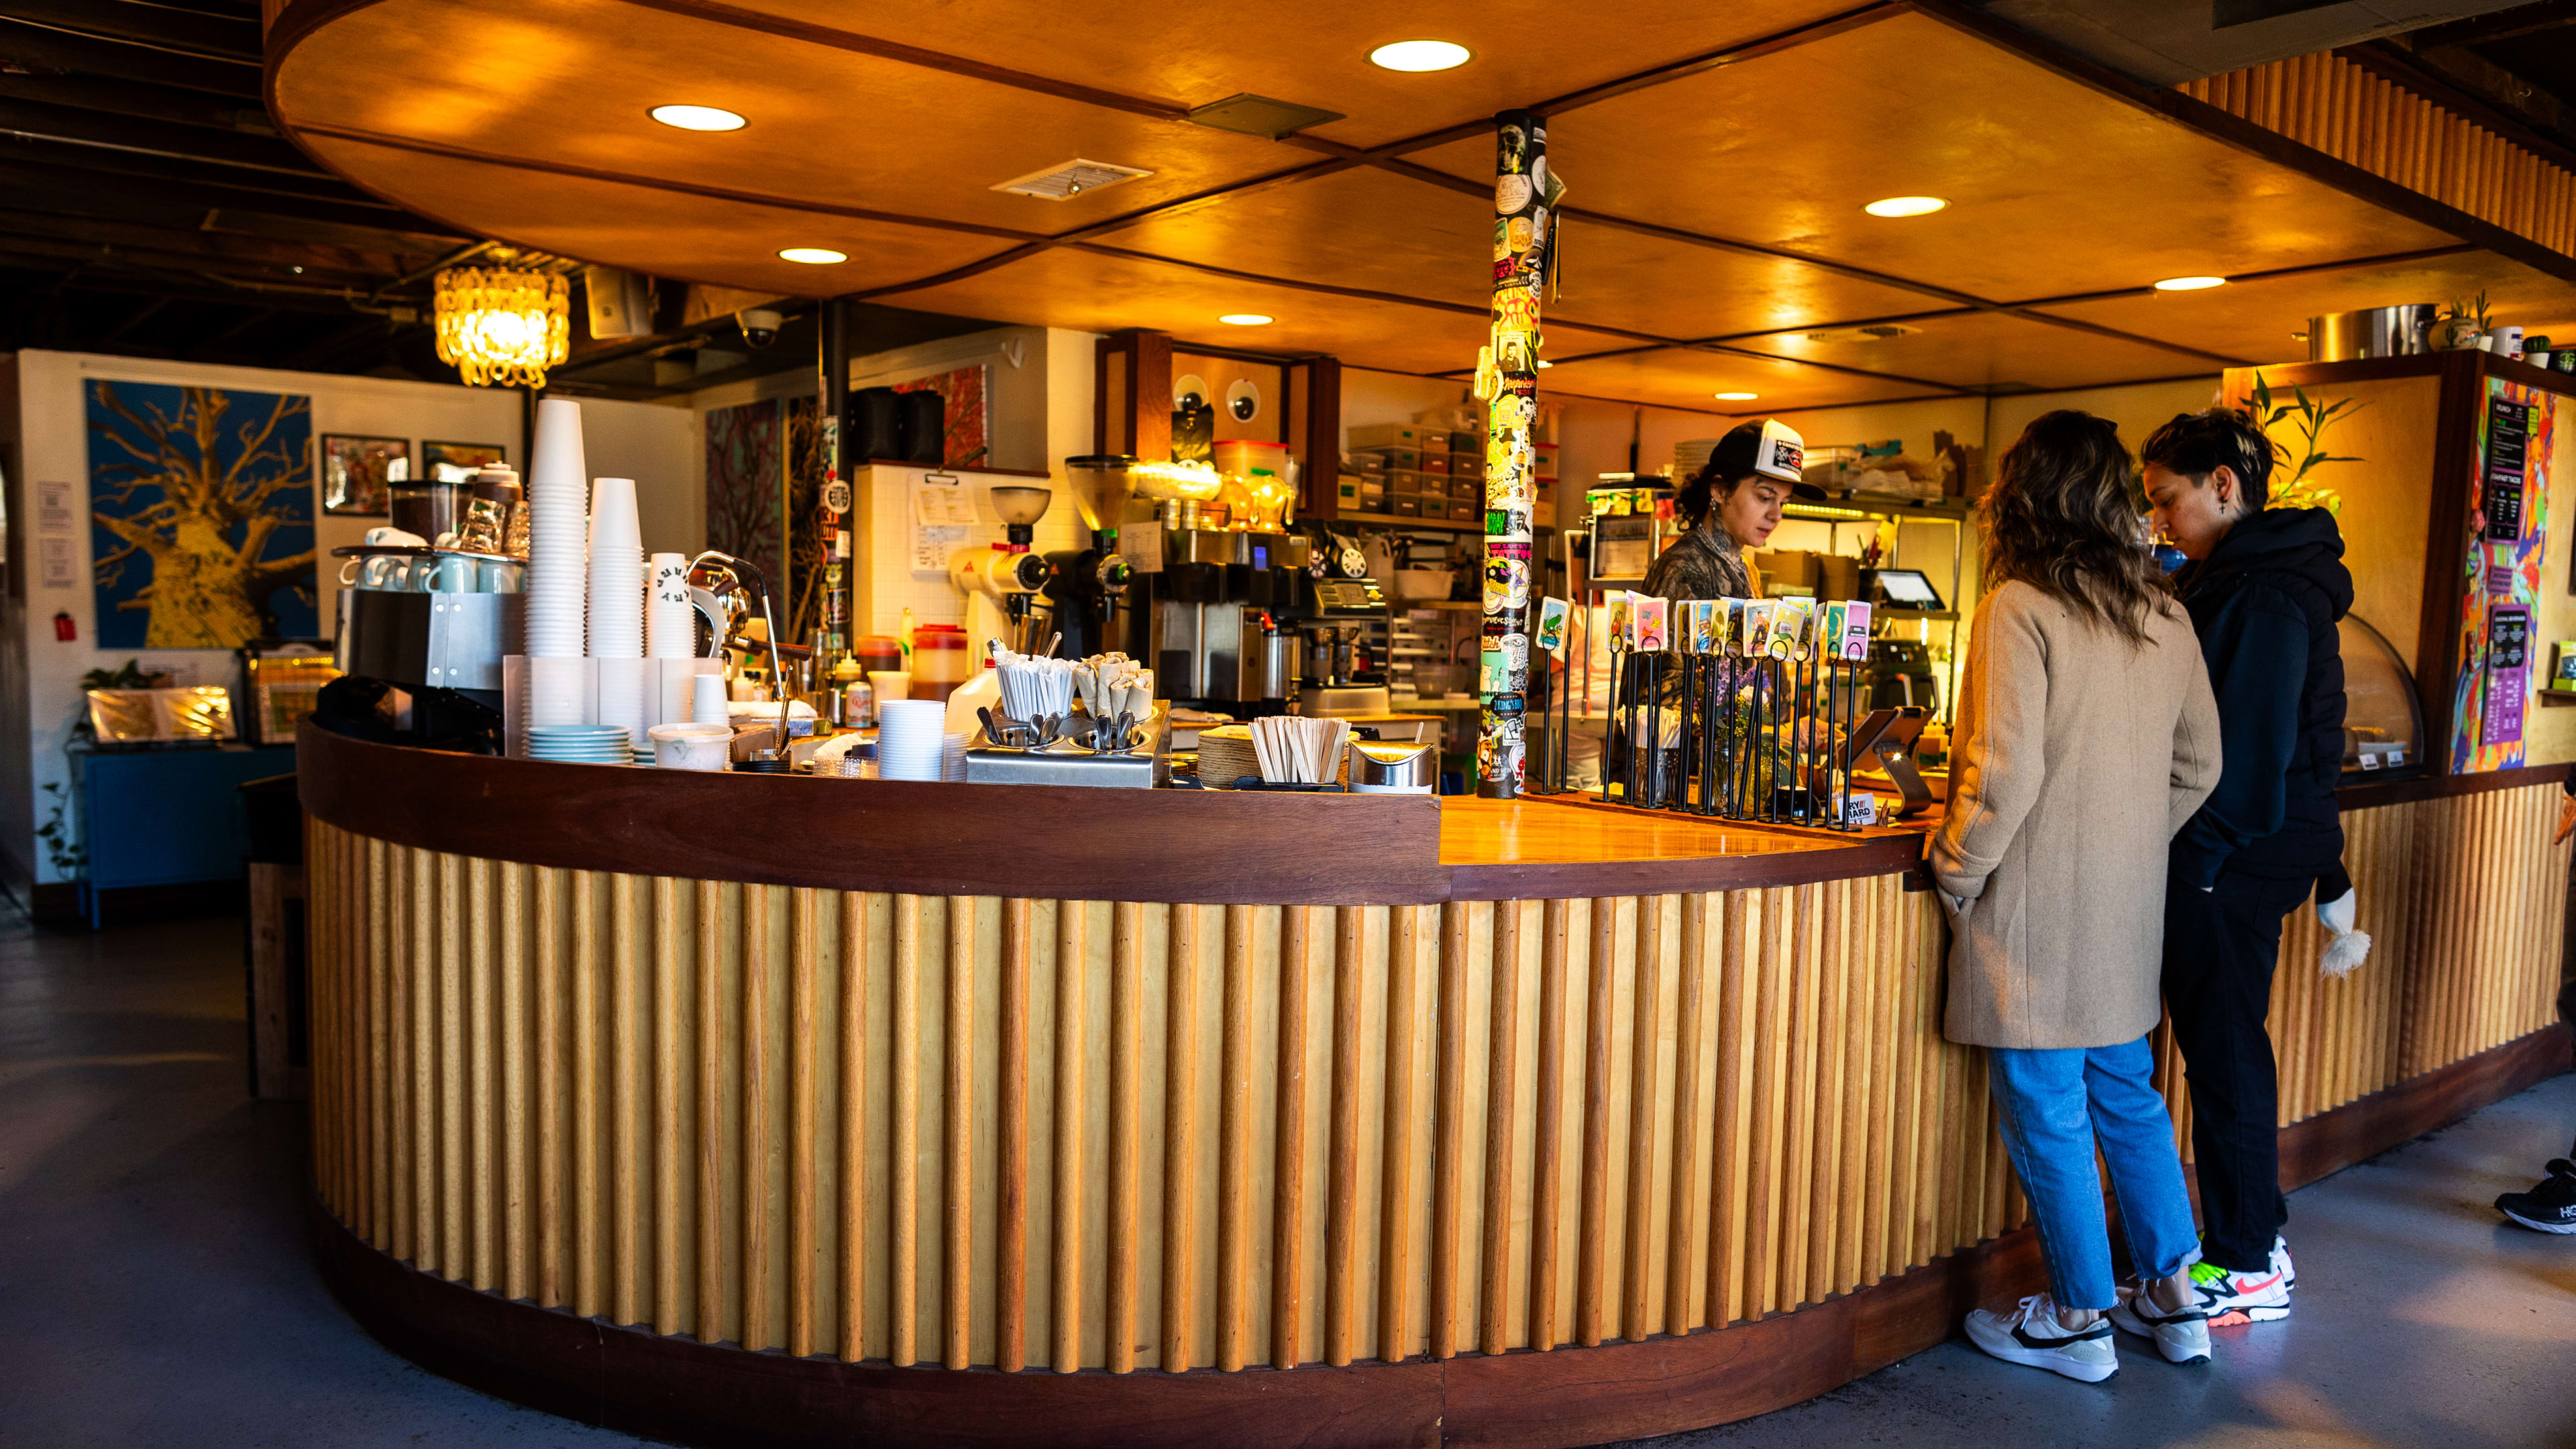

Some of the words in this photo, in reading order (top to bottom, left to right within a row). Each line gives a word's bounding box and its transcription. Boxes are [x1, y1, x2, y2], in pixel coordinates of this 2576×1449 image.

[1494, 700, 1498, 710] 2
[1497, 699, 1515, 710] KING'S
[1515, 698, 1523, 710] BBQ
